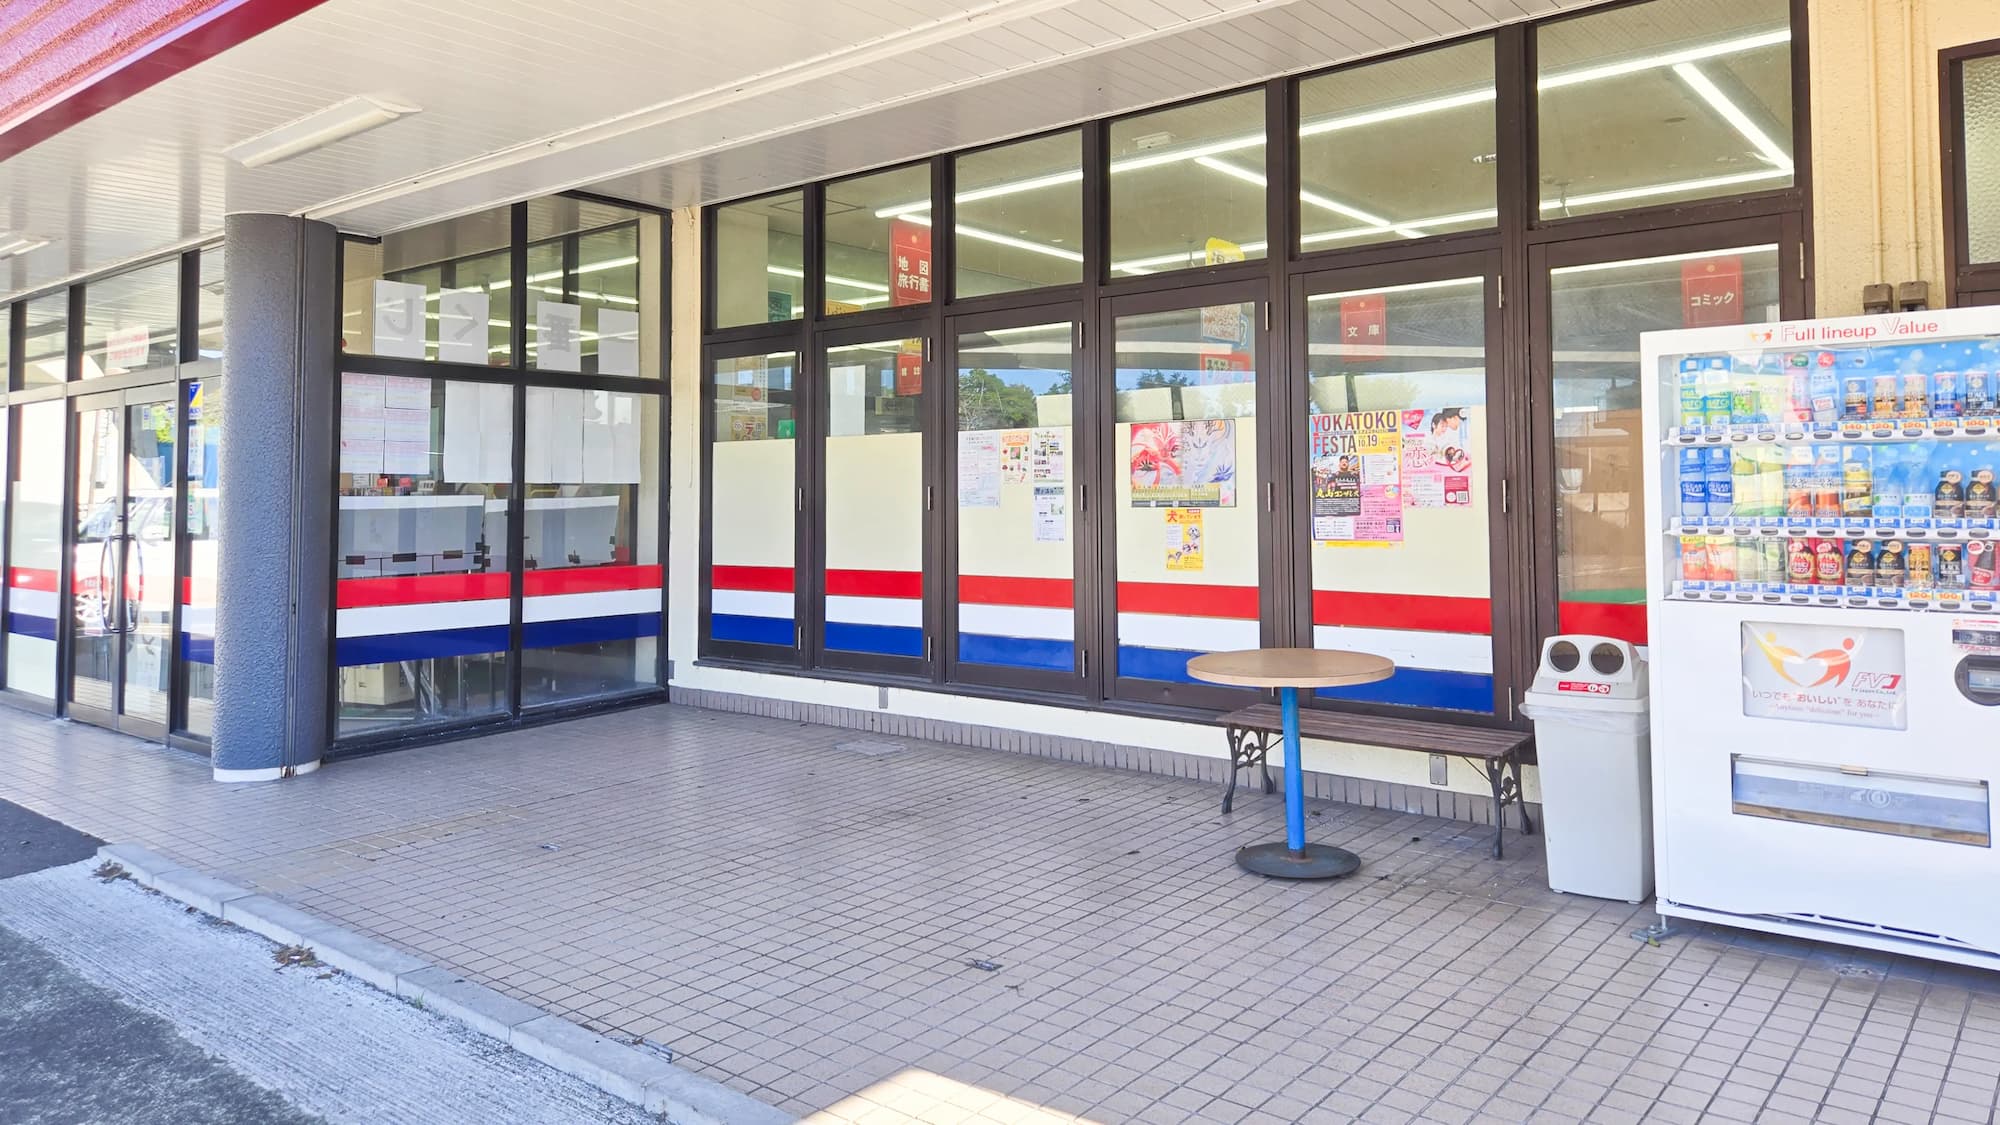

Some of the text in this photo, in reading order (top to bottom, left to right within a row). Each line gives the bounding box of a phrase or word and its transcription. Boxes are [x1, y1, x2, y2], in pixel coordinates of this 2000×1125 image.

[898, 273, 929, 292] 旅行書
[1691, 291, 1735, 307] コミック
[1782, 317, 1938, 342] Full lineup Value
[1312, 411, 1397, 433] YOKATOKO
[1313, 435, 1357, 454] FESTA
[1852, 671, 1902, 690] FVJ
[1752, 690, 1792, 701] いつでも
